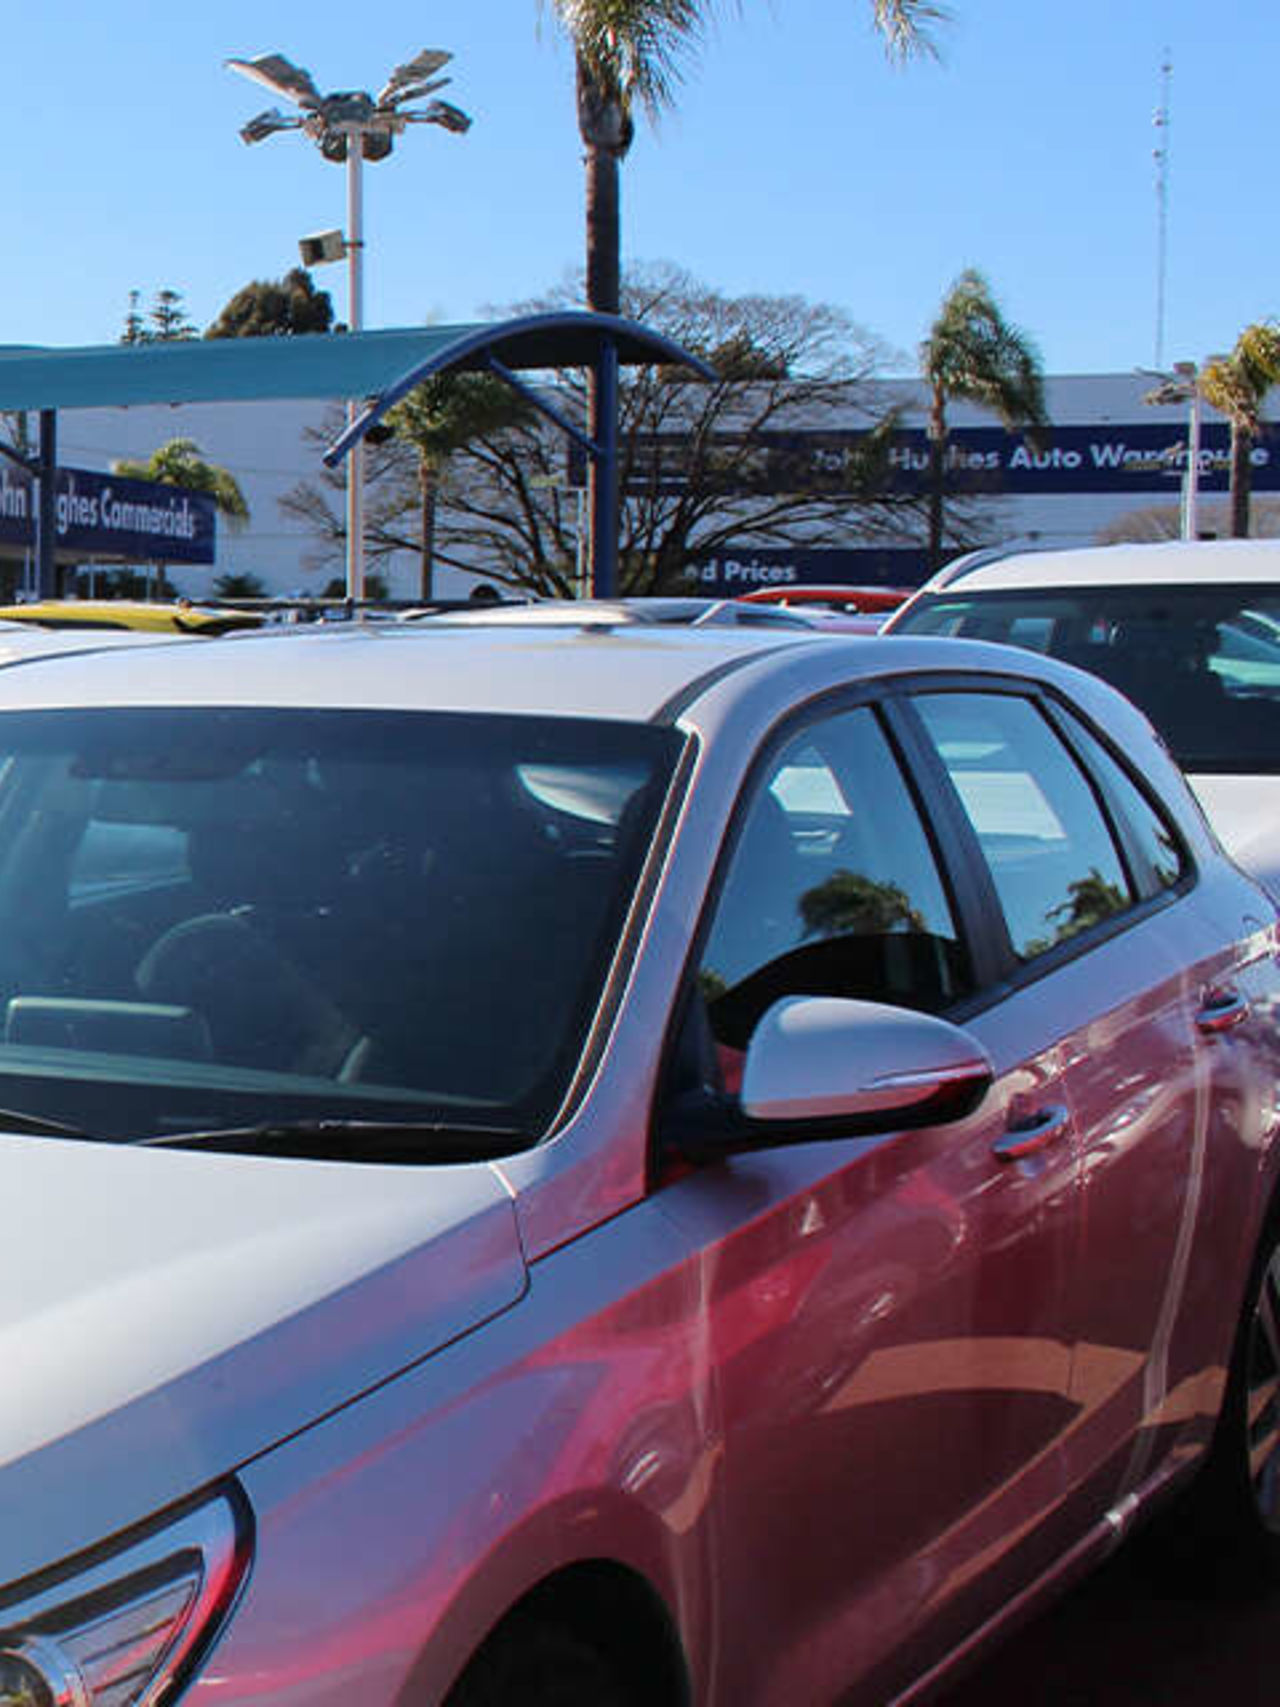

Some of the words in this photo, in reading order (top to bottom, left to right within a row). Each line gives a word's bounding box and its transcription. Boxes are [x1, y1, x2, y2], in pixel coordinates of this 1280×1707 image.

[1010, 447, 1081, 468] Auto
[101, 488, 194, 539] Commercials
[724, 560, 796, 581] Prices
